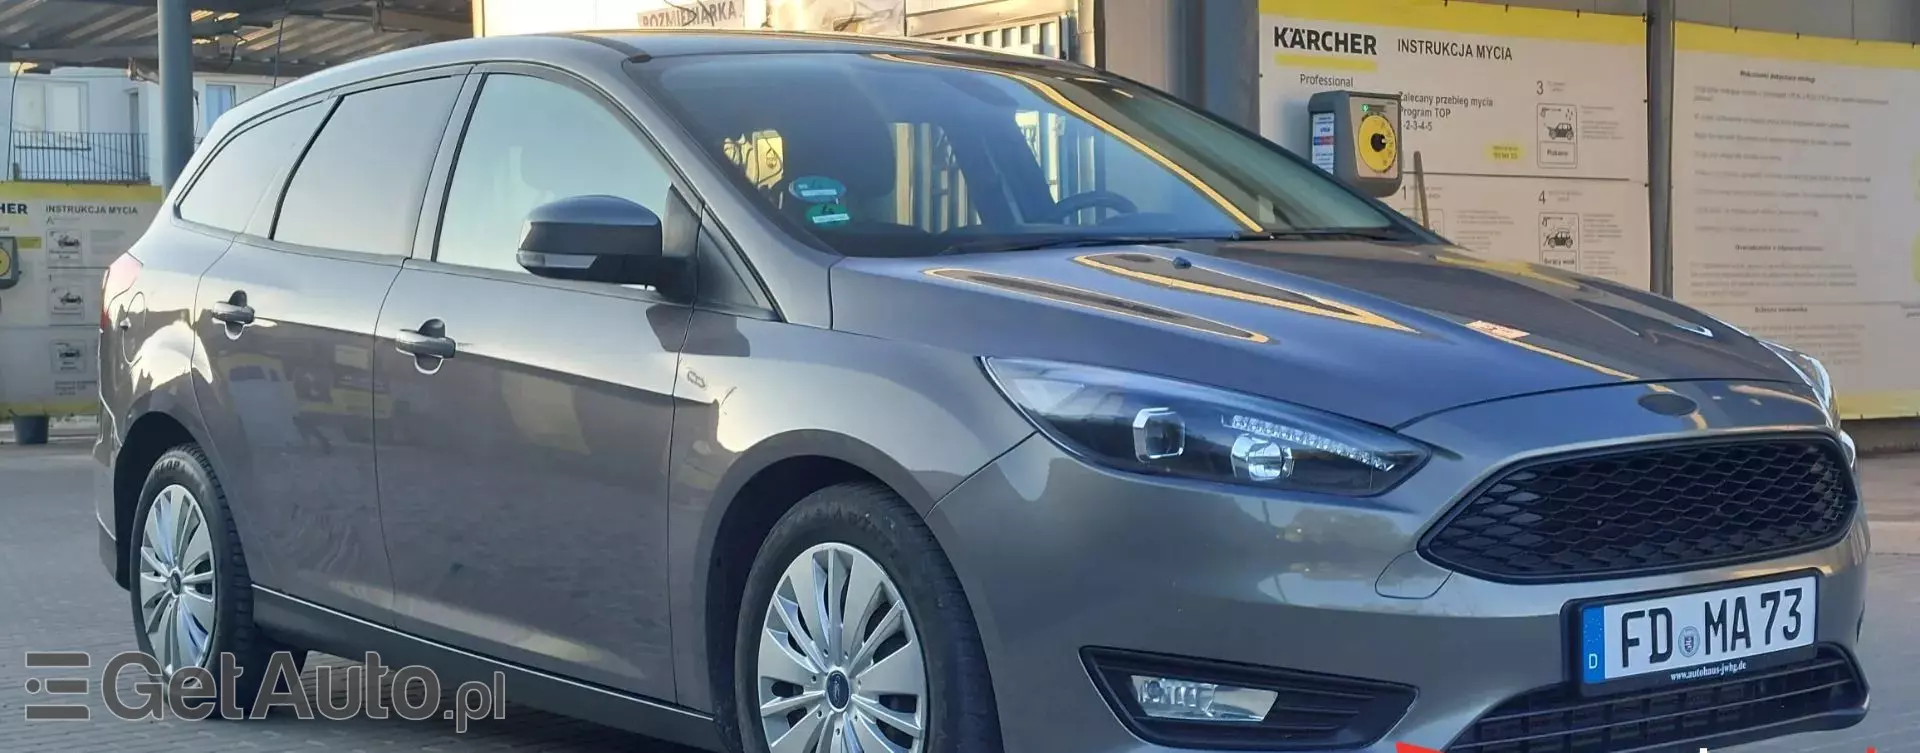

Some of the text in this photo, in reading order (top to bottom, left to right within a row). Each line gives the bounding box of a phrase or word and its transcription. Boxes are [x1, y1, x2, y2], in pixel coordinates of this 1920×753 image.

[1273, 26, 1378, 55] KÄRCHER
[1397, 38, 1513, 61] INSTRUKCJA MYCIA
[1300, 73, 1354, 88] Professional
[1536, 80, 1544, 95] 3
[1435, 96, 1468, 108] przebieg
[1470, 98, 1493, 108] mycia
[1434, 108, 1451, 118] TOP
[1538, 190, 1546, 205] 4
[45, 204, 138, 214] INSTRUKCJA MYCIA
[1620, 587, 1803, 668] FD MA 73
[1588, 653, 1598, 669] D
